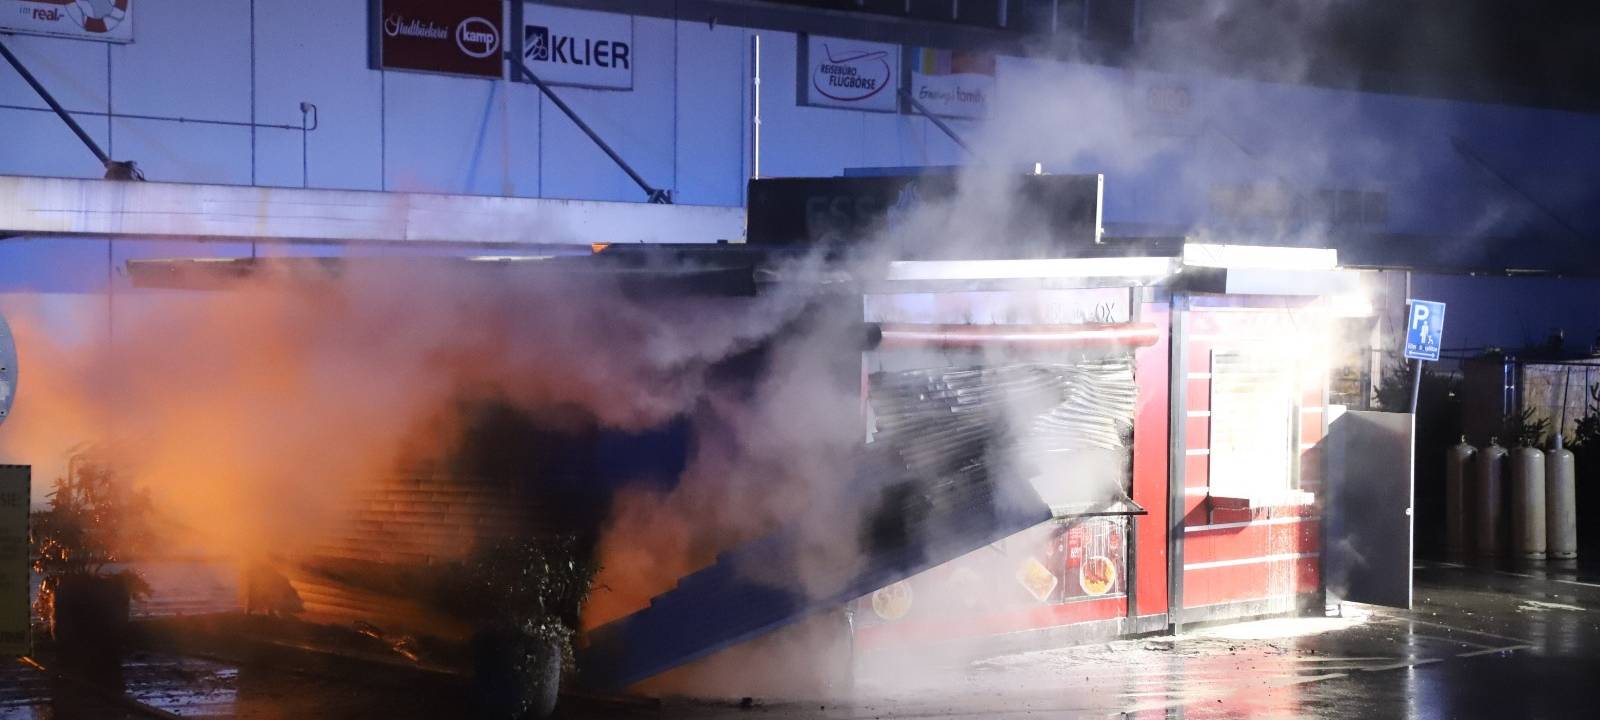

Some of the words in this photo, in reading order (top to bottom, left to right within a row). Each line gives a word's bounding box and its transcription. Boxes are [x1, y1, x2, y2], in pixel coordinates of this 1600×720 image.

[384, 13, 449, 40] Stadtbäckerei
[462, 23, 495, 52] kamp
[551, 35, 630, 70] KLIER
[820, 63, 857, 76] REISEBÜRO
[828, 75, 876, 90] FLUGBÖRSE
[1412, 304, 1430, 330] P
